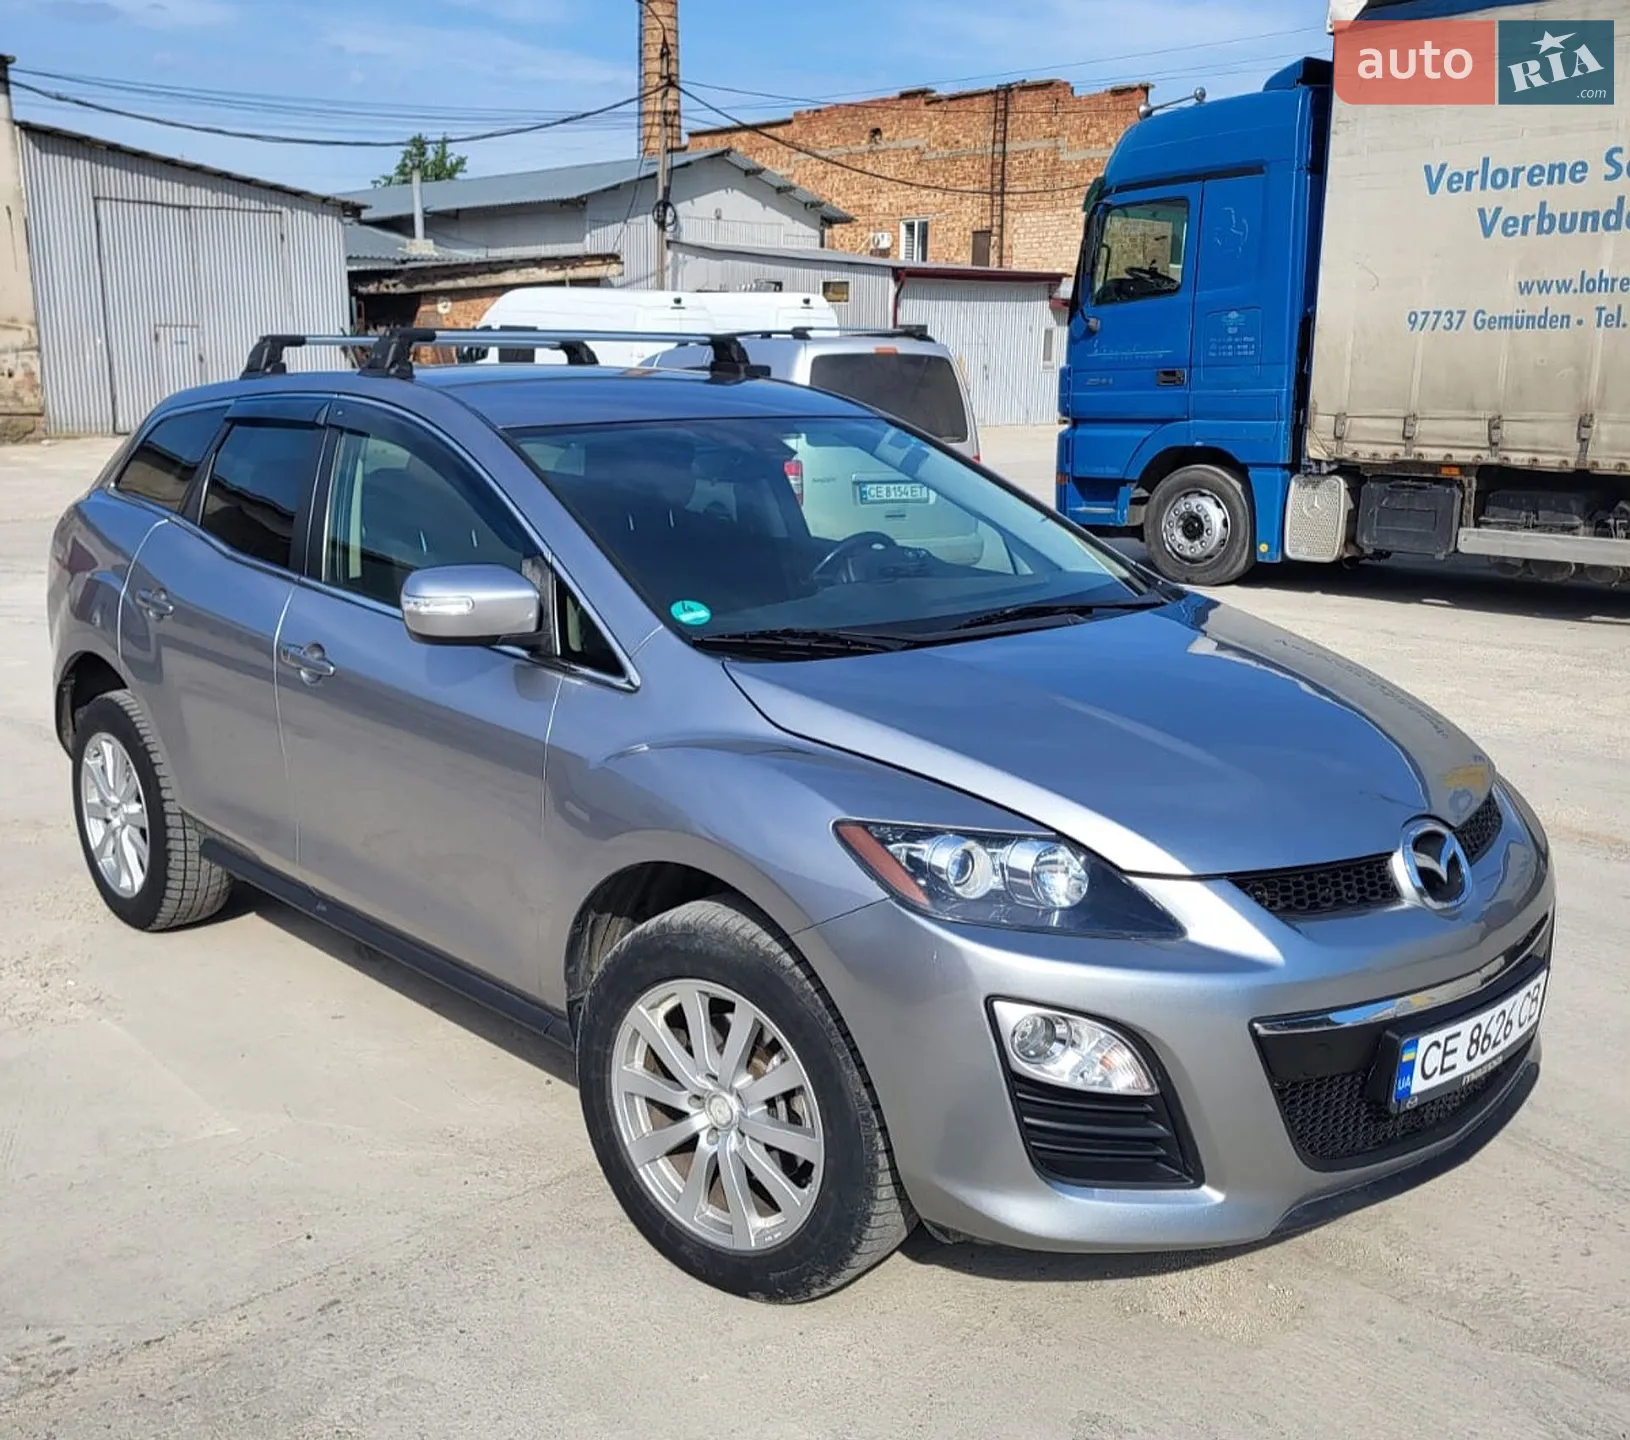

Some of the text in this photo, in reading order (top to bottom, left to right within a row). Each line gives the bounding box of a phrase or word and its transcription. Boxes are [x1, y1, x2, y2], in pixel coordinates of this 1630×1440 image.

[1424, 146, 1630, 195] Verlorene S
[1477, 195, 1630, 239] Verbund
[1407, 304, 1627, 332] 97737 Gemünden Tel.
[1420, 1031, 1461, 1081] CE
[1466, 1002, 1515, 1062] 8626
[1518, 983, 1541, 1029] CB
[1397, 1074, 1411, 1090] UA
